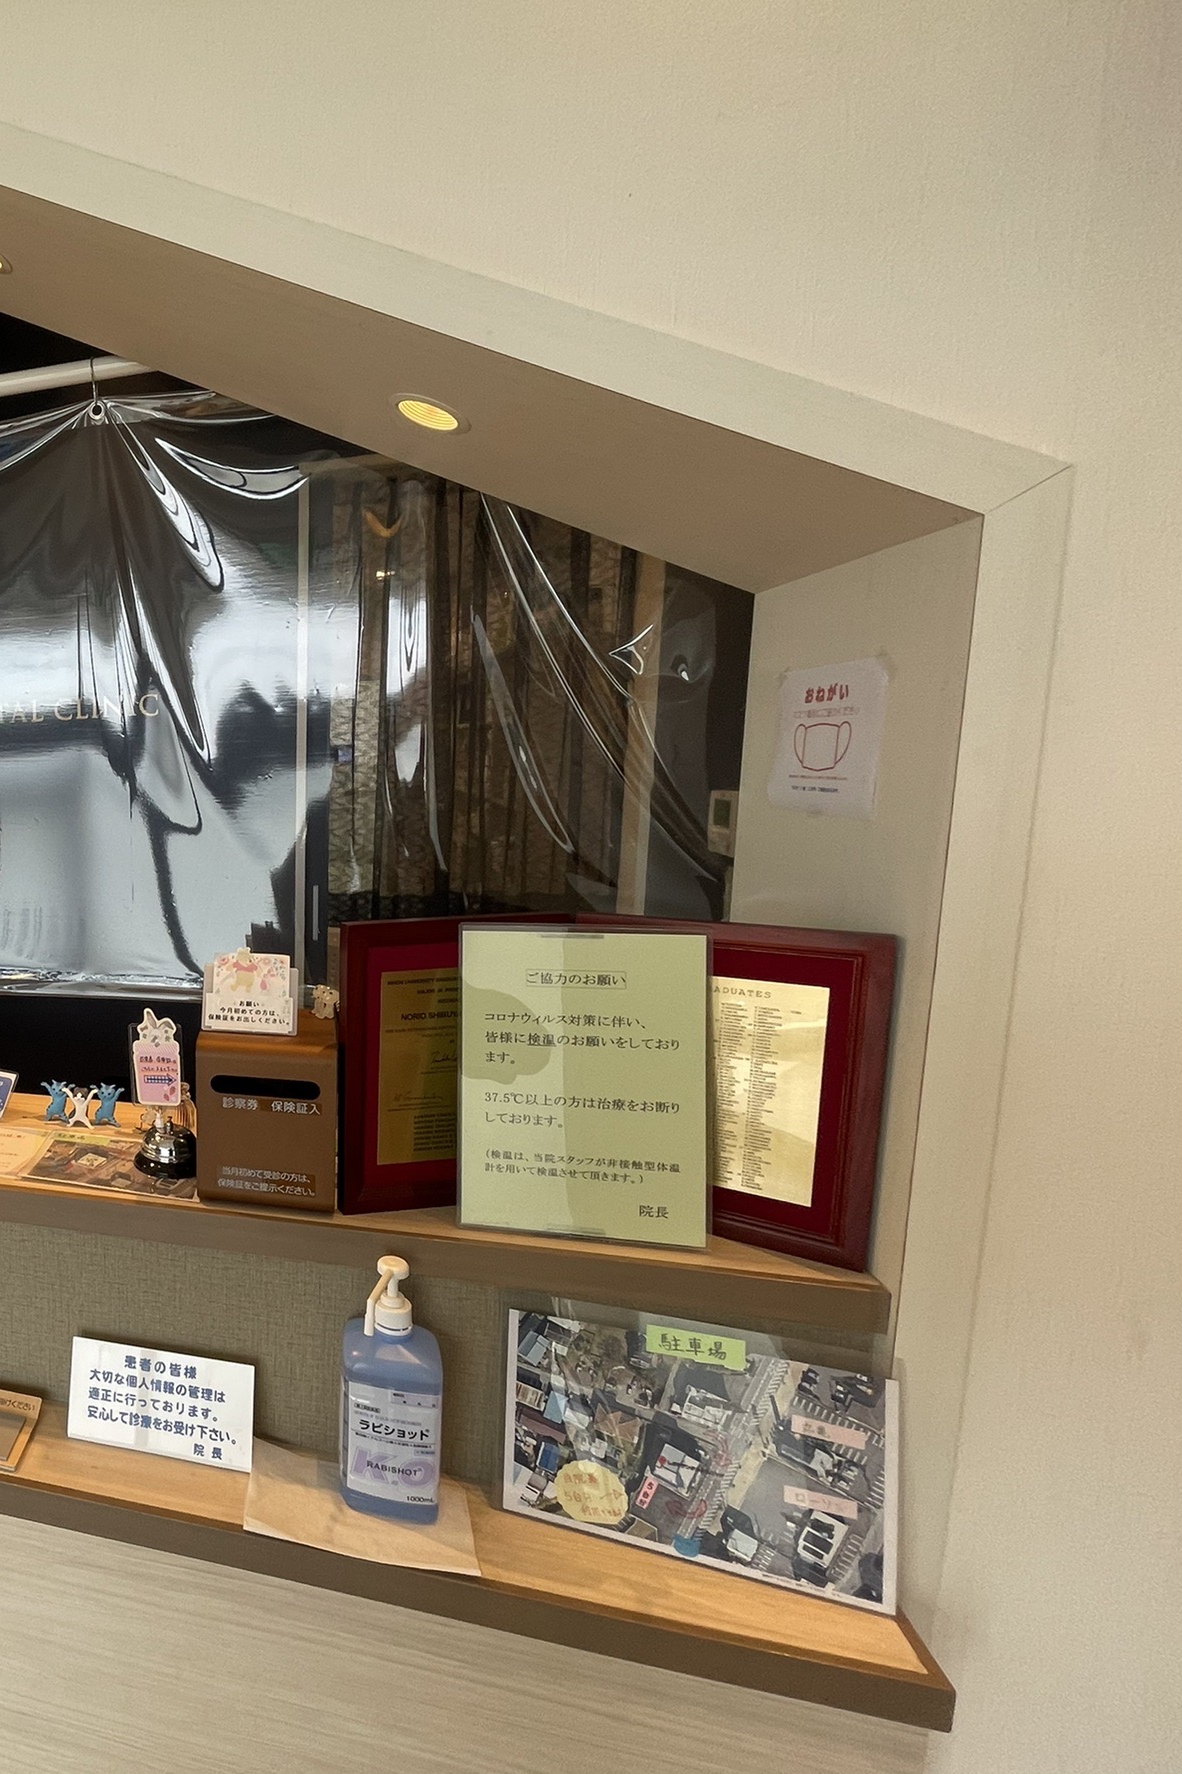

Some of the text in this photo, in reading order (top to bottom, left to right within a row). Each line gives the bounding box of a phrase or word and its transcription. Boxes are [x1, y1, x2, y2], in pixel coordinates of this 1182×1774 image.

[54, 693, 160, 722] CLINIC
[527, 971, 626, 987] ご協力のお願い
[219, 1006, 280, 1018] 今月初めての方は、
[238, 999, 261, 1008] お願い
[208, 1014, 290, 1027] 保険証をお出しください。
[484, 1010, 648, 1030] コロナウィルス対策に伴い、
[485, 1031, 681, 1051] 皆様に検温のお願いをしており
[484, 1051, 516, 1065] ます。
[222, 1096, 321, 1116] 診察券 保険証入
[484, 1092, 681, 1115] 37.5℃以上の方は治療をお断り
[485, 1111, 564, 1129] しております。
[222, 1166, 311, 1184] 当月初めて受診の方は、
[217, 1178, 316, 1197] 保険証をご提示ください。
[638, 1204, 669, 1220] 院長
[658, 1332, 727, 1361] 駐車場
[124, 1354, 198, 1380] 患者の皆様
[89, 1368, 226, 1403] 大切な個人情報の管理は
[88, 1386, 218, 1422] 適正に行っております。
[87, 1405, 237, 1445] 安心して診療をお受け下さい。
[359, 1419, 429, 1441] ラビショット
[193, 1443, 223, 1460] 院長
[367, 1460, 418, 1476] RABISHOT
[406, 1495, 434, 1504] 1000mL
